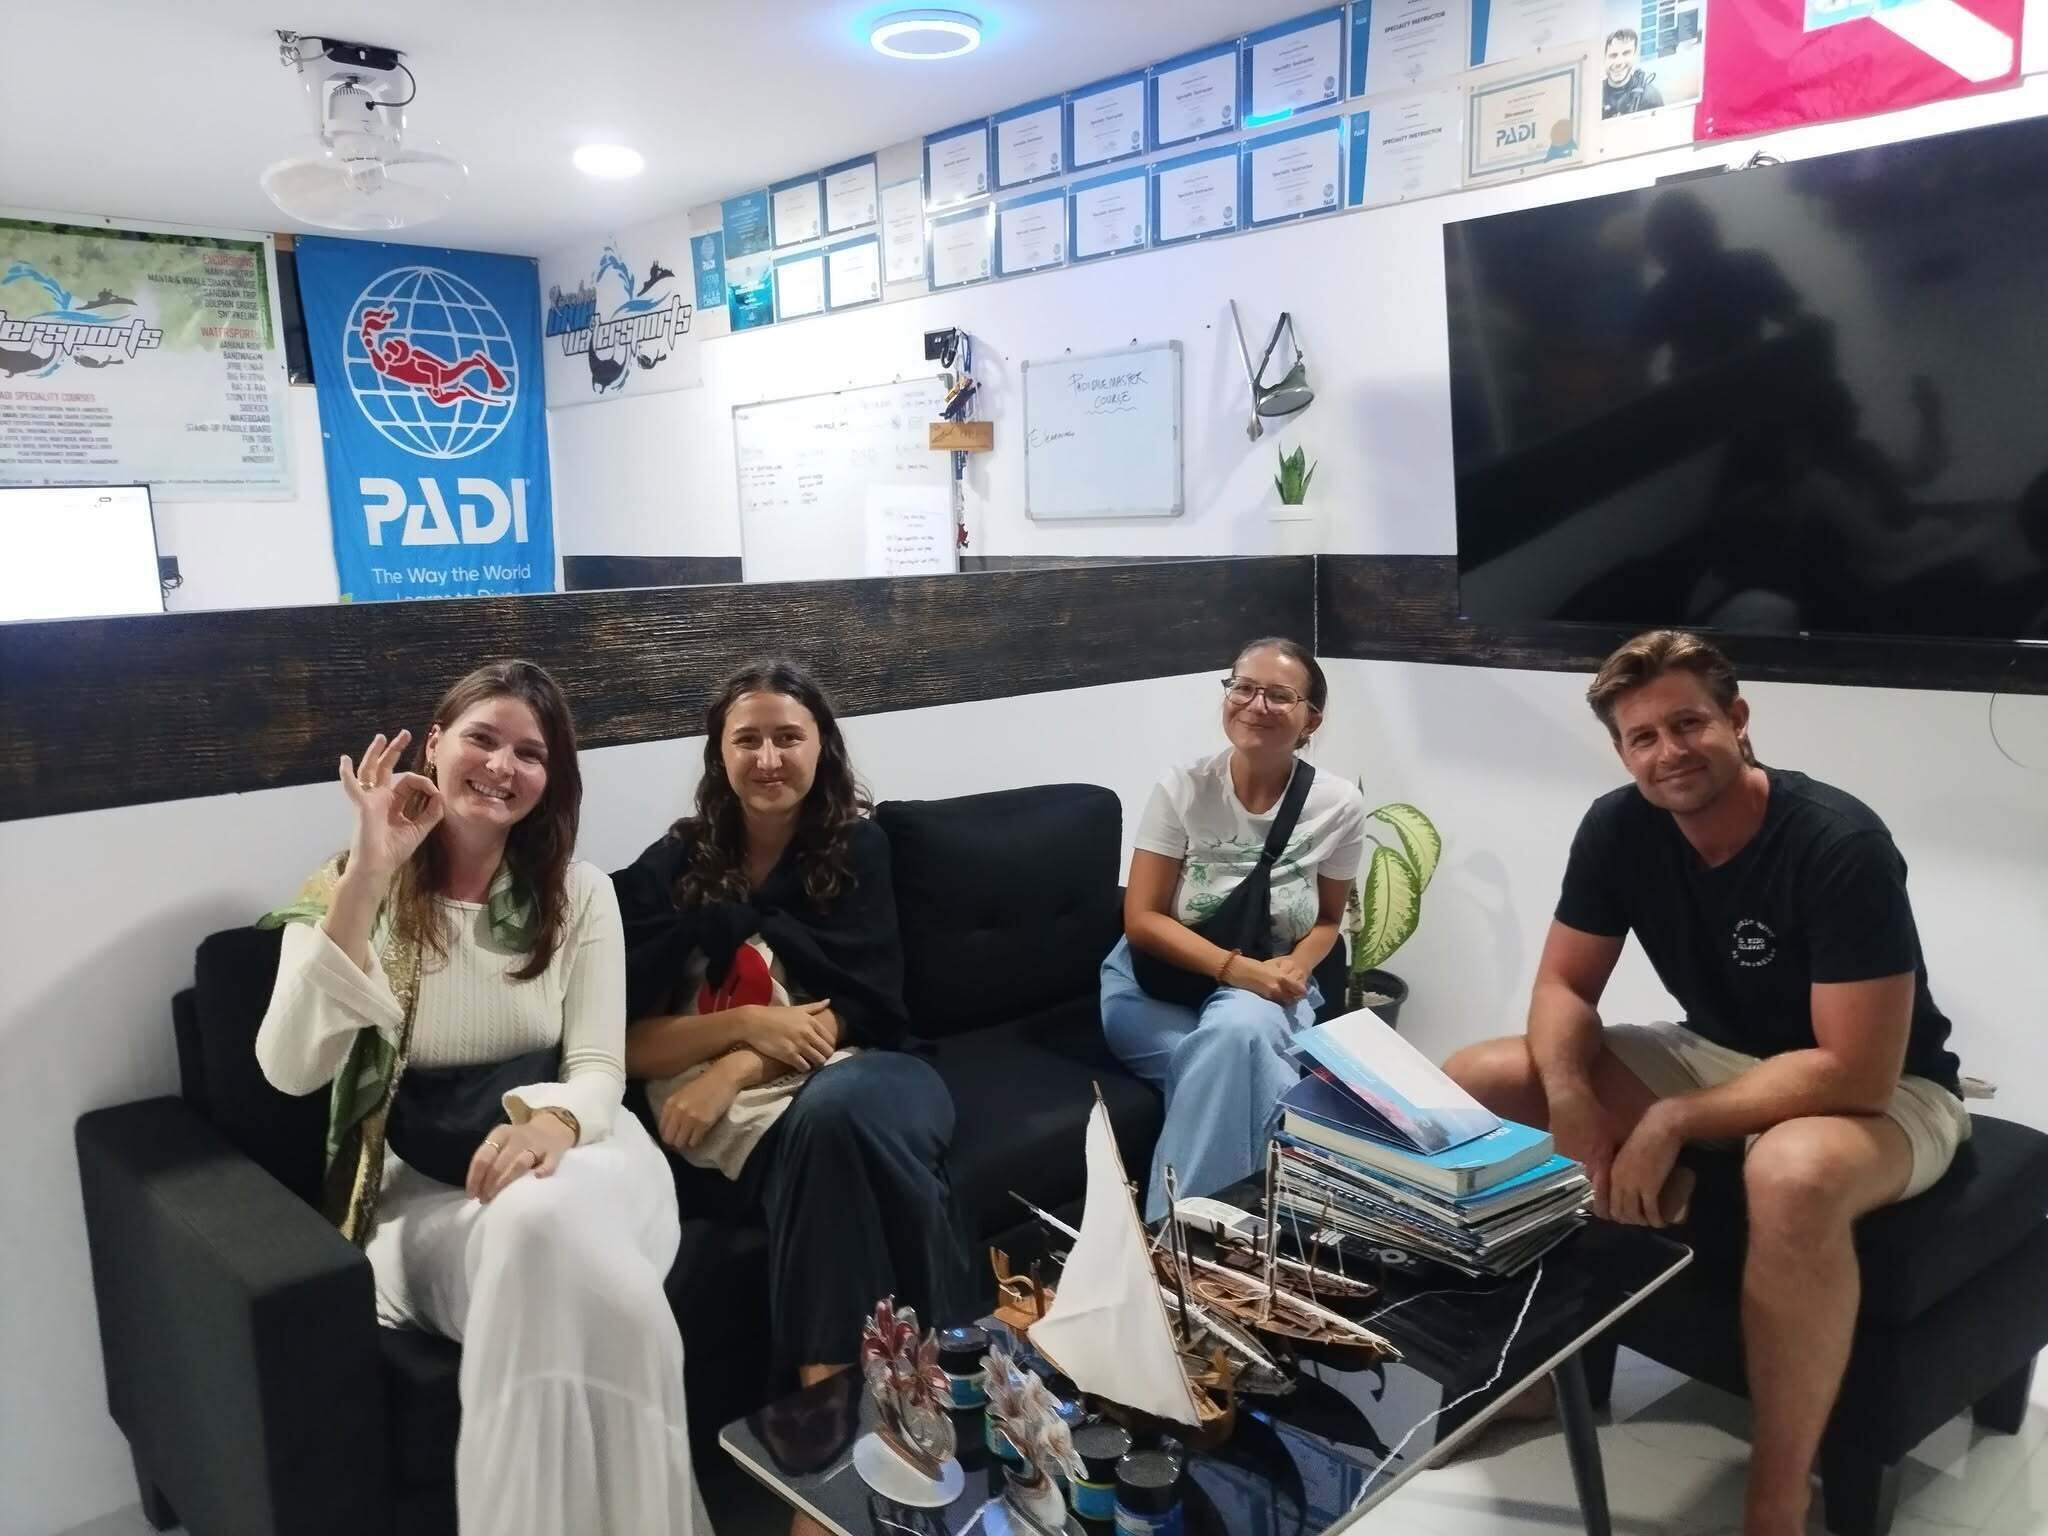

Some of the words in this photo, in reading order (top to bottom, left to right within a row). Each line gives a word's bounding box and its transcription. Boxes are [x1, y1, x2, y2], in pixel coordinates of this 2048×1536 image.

[1495, 121, 1537, 148] PADI
[359, 476, 530, 546] PADI
[371, 568, 403, 585] The
[406, 567, 448, 587] Way
[451, 567, 480, 582] the
[482, 563, 532, 581] World
